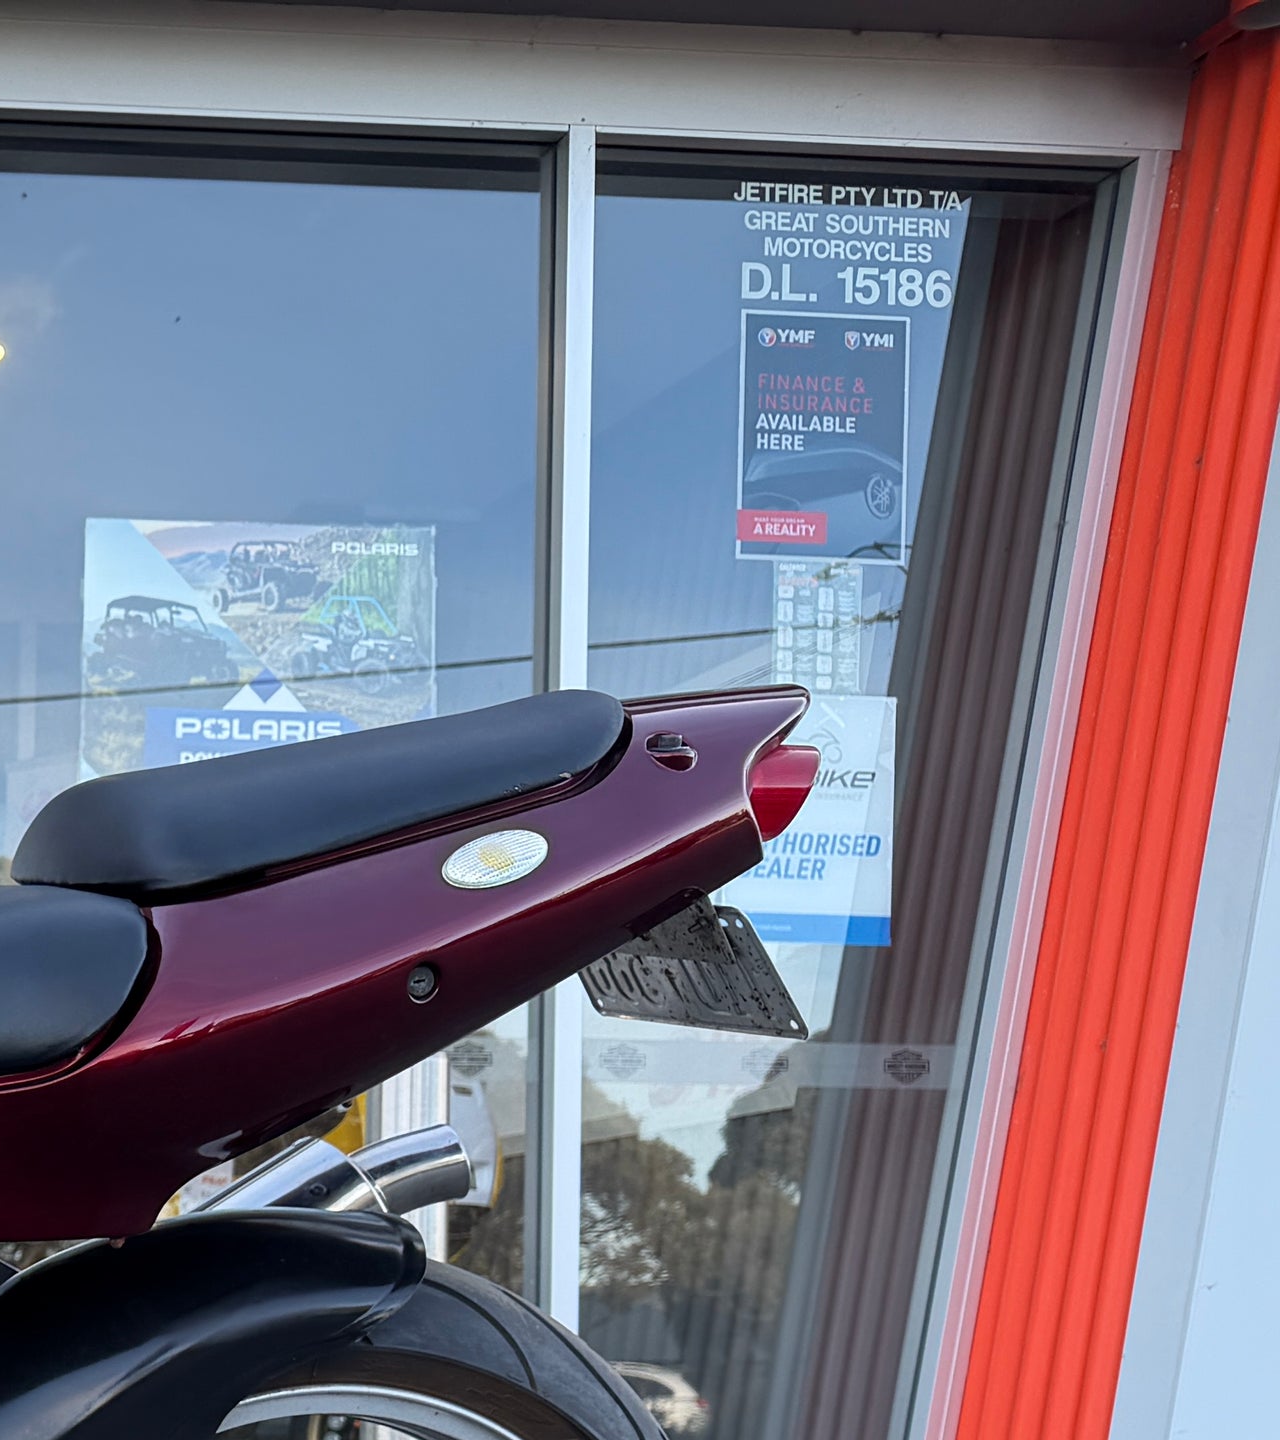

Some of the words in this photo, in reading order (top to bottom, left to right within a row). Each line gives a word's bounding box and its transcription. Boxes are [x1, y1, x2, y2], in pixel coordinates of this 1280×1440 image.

[734, 182, 823, 204] JETFIRE
[832, 186, 876, 207] PTY
[883, 188, 922, 209] LTD
[930, 190, 963, 212] T/A
[744, 210, 819, 233] GREAT
[826, 214, 950, 238] SOUTHERN
[764, 237, 932, 263] MOTORCYCLES
[741, 262, 817, 302] D.L.
[837, 266, 952, 308] 15186
[777, 329, 815, 344] YMF
[862, 333, 894, 348] YMI
[758, 373, 845, 394] FINANCE
[853, 377, 865, 394] &
[758, 394, 873, 414] INSURANCE
[756, 413, 856, 433] AVAILABLE
[756, 433, 804, 451] HERE
[753, 522, 763, 535] A
[765, 523, 816, 537] REALITY
[331, 541, 419, 556] POLARIS
[175, 717, 342, 742] POLARIS
